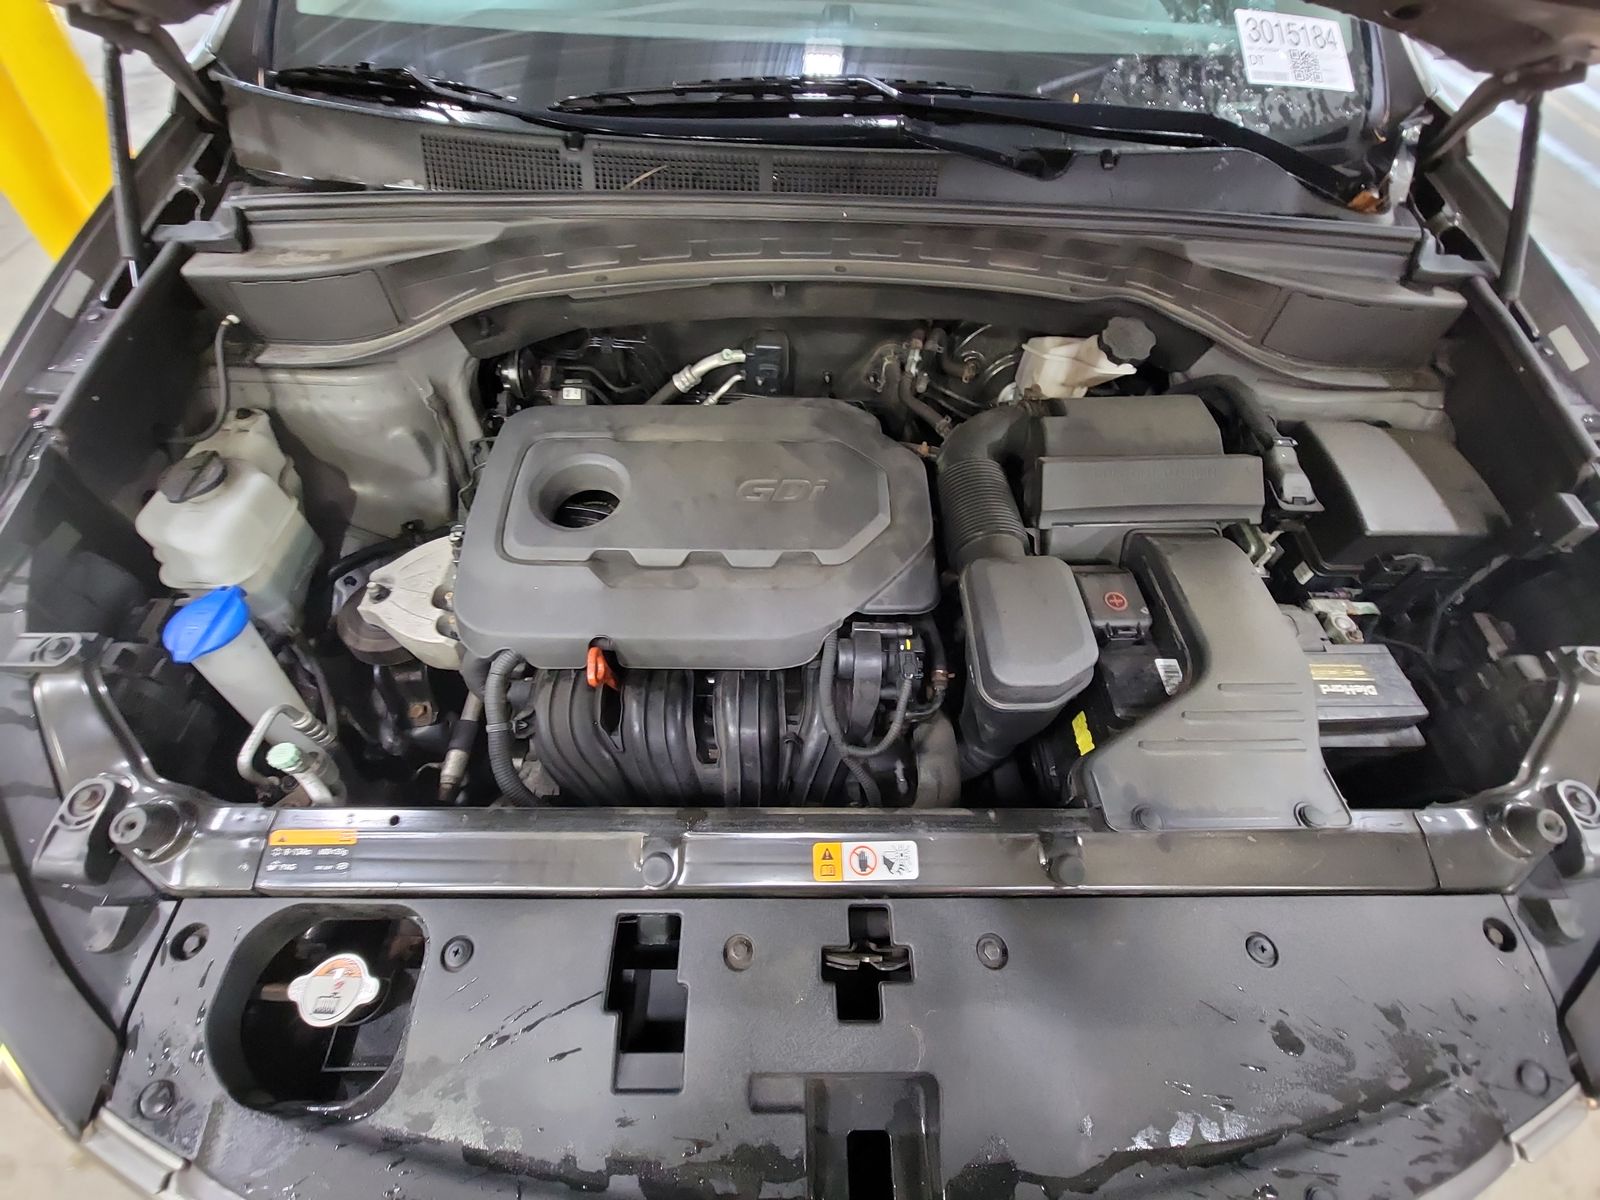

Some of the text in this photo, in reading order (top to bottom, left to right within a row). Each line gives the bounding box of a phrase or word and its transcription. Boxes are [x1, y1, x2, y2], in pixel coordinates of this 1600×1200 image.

[1246, 17, 1338, 49] 3015184
[736, 479, 829, 503] GDi
[1319, 684, 1378, 696] DieHard
